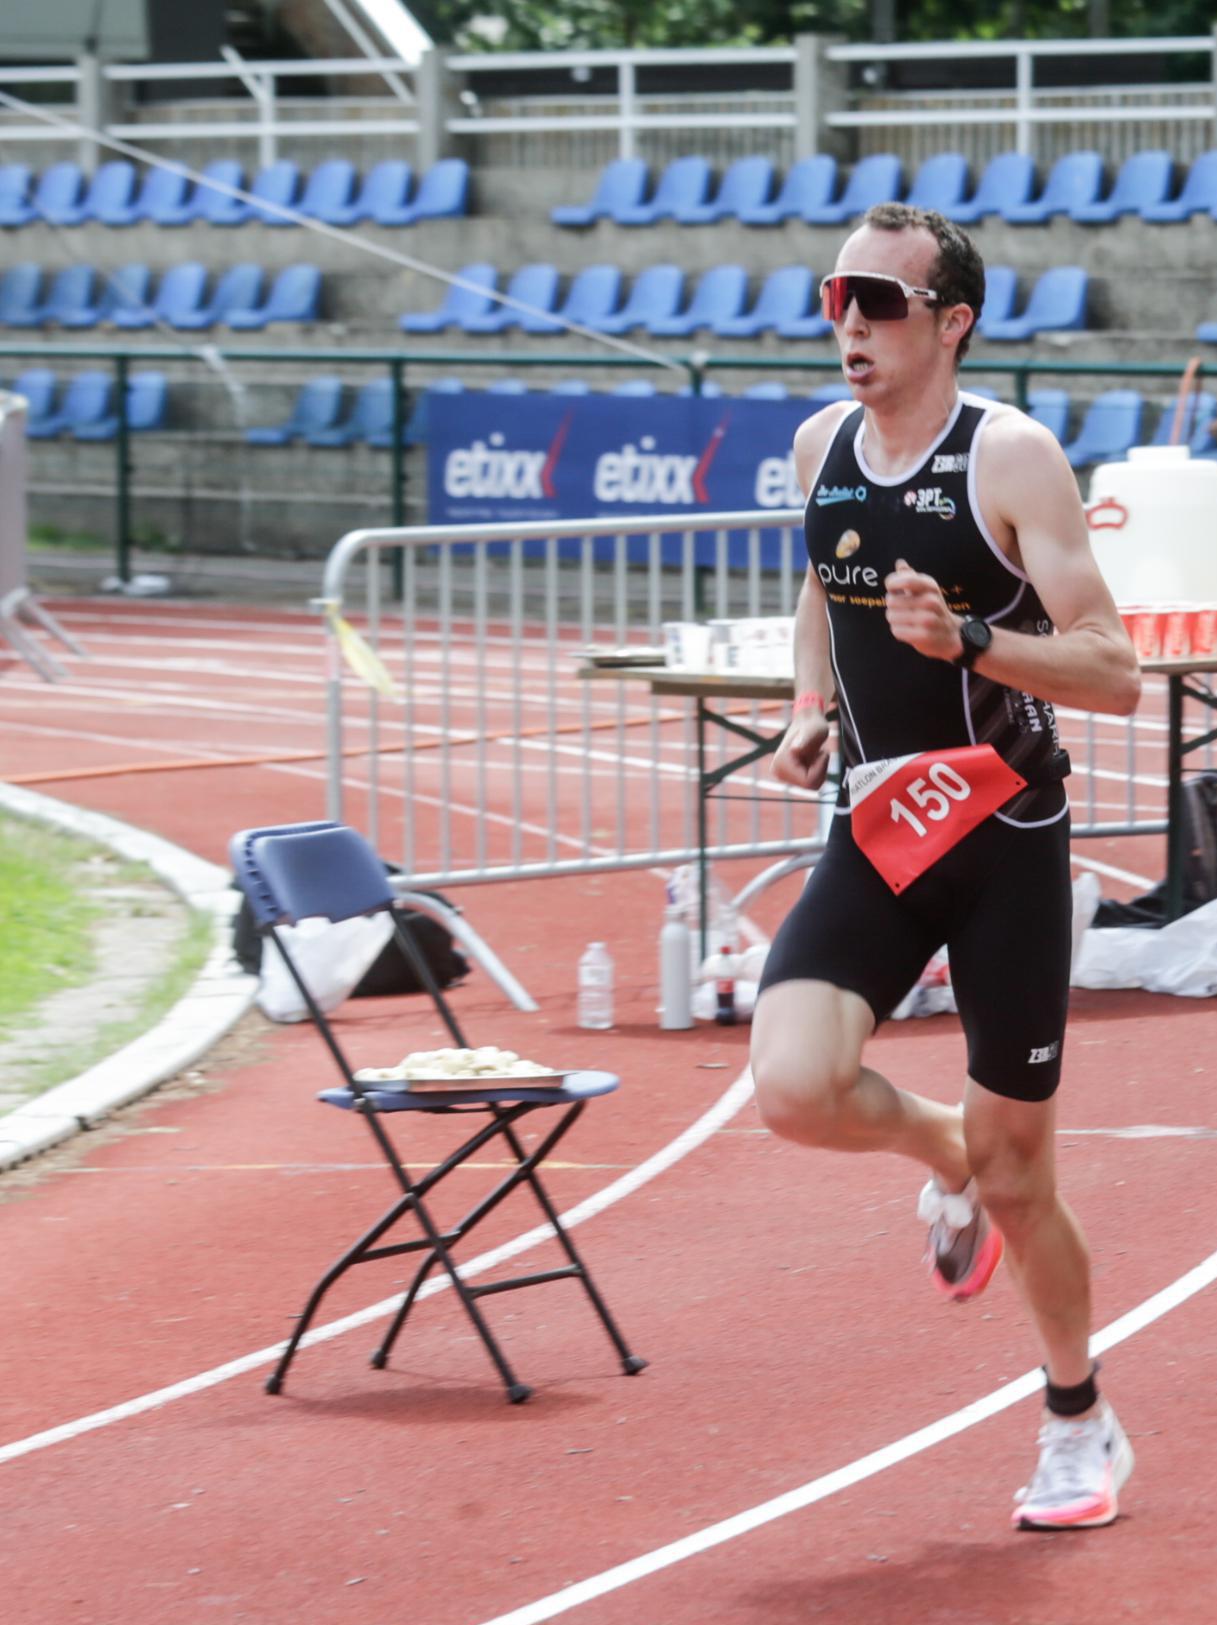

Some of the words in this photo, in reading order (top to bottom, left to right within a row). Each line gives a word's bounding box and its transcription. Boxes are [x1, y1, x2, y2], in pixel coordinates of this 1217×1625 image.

[444, 432, 546, 499] etixx
[594, 436, 698, 505] etixx
[818, 563, 878, 587] pure
[889, 762, 971, 838] 150
